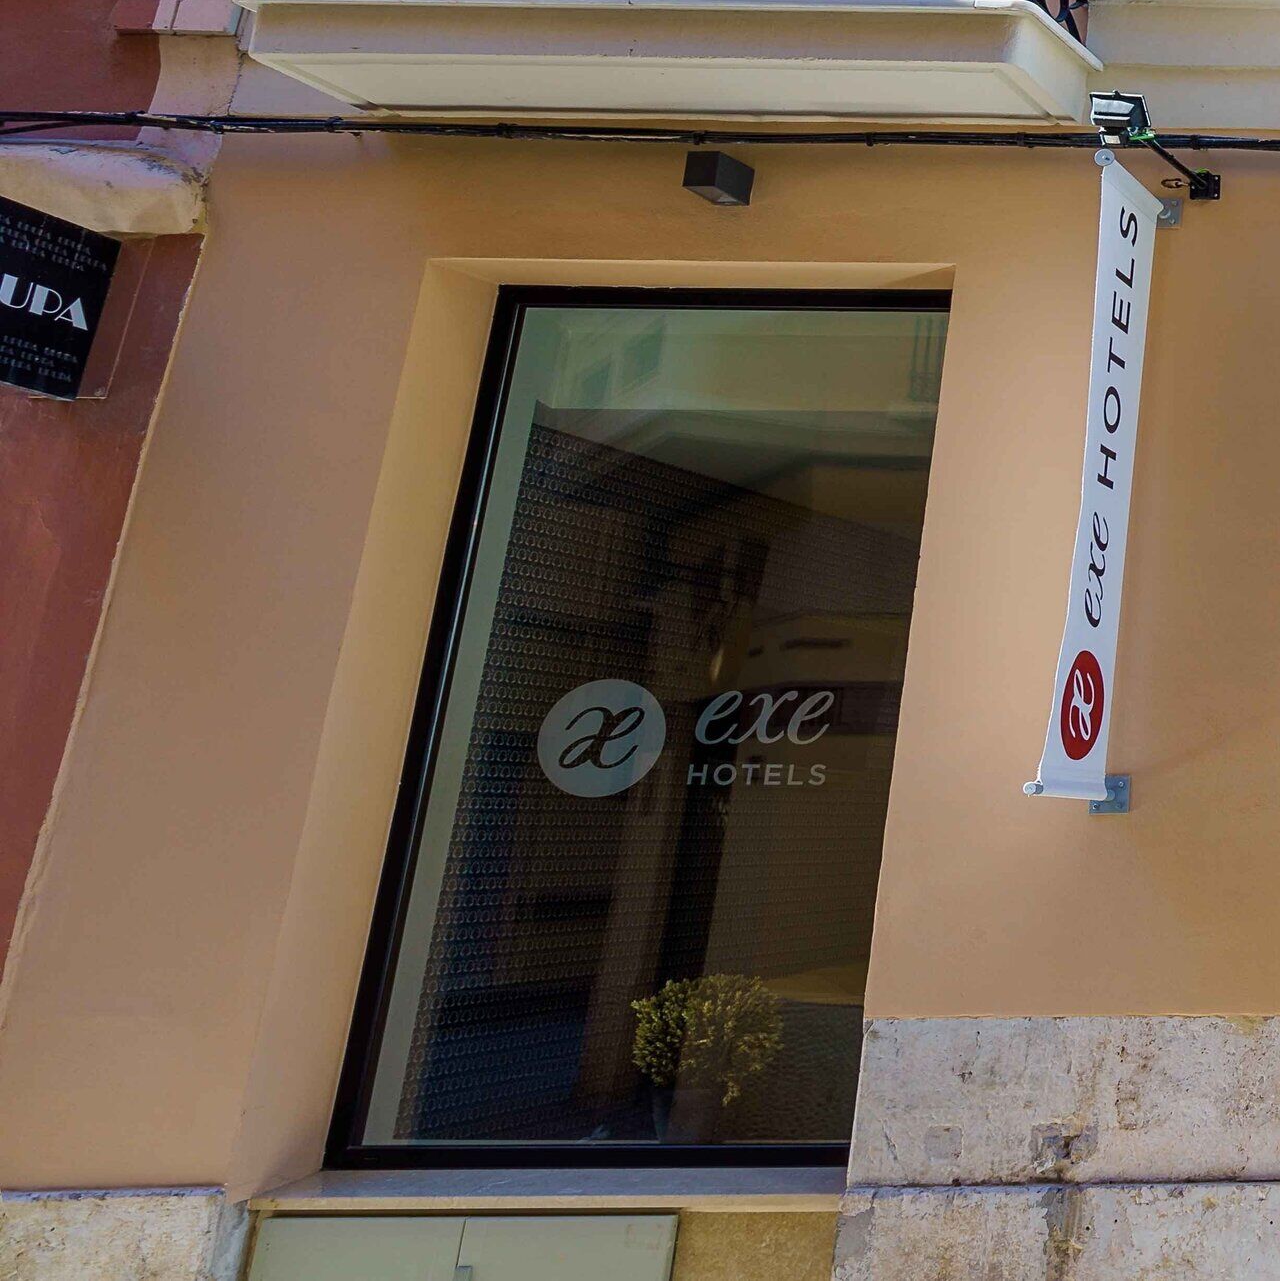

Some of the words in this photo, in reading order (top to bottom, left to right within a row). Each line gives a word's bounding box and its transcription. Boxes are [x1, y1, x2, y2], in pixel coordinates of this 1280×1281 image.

[1096, 205, 1140, 491] HOTELS
[1084, 510, 1112, 629] exe
[694, 689, 836, 746] exe
[686, 762, 828, 787] HOTELS
